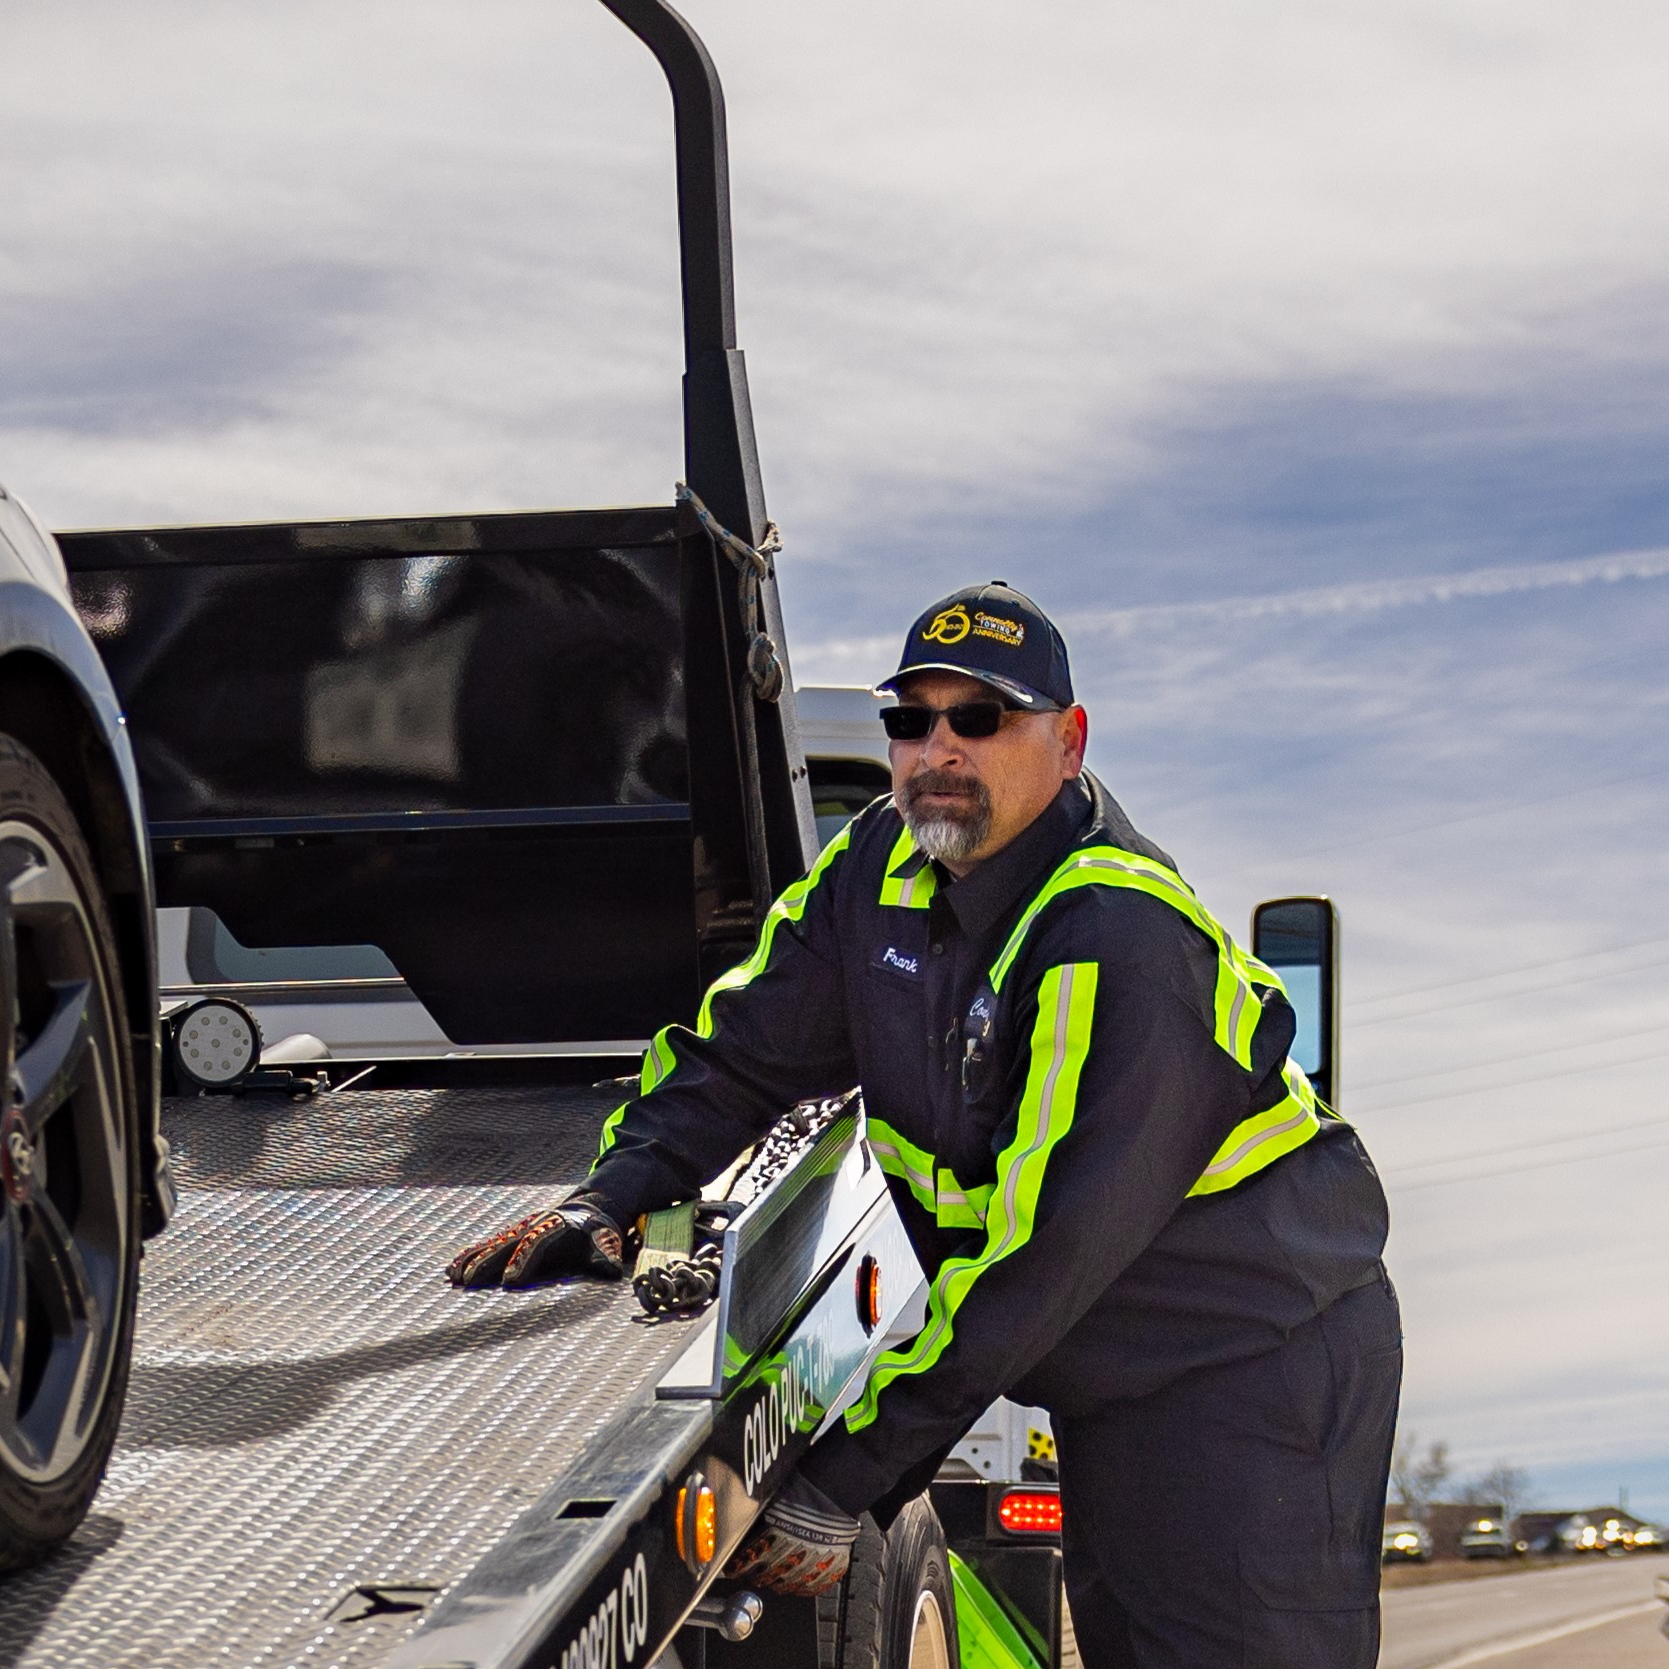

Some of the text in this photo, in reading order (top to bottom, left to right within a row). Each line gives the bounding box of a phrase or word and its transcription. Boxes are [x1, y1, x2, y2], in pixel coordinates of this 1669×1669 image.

[972, 627, 1022, 646] ANNIVERSARY
[980, 619, 1011, 634] TOWING
[883, 947, 919, 973] Frank
[744, 1381, 779, 1496] COLO
[621, 1552, 648, 1663] CO
